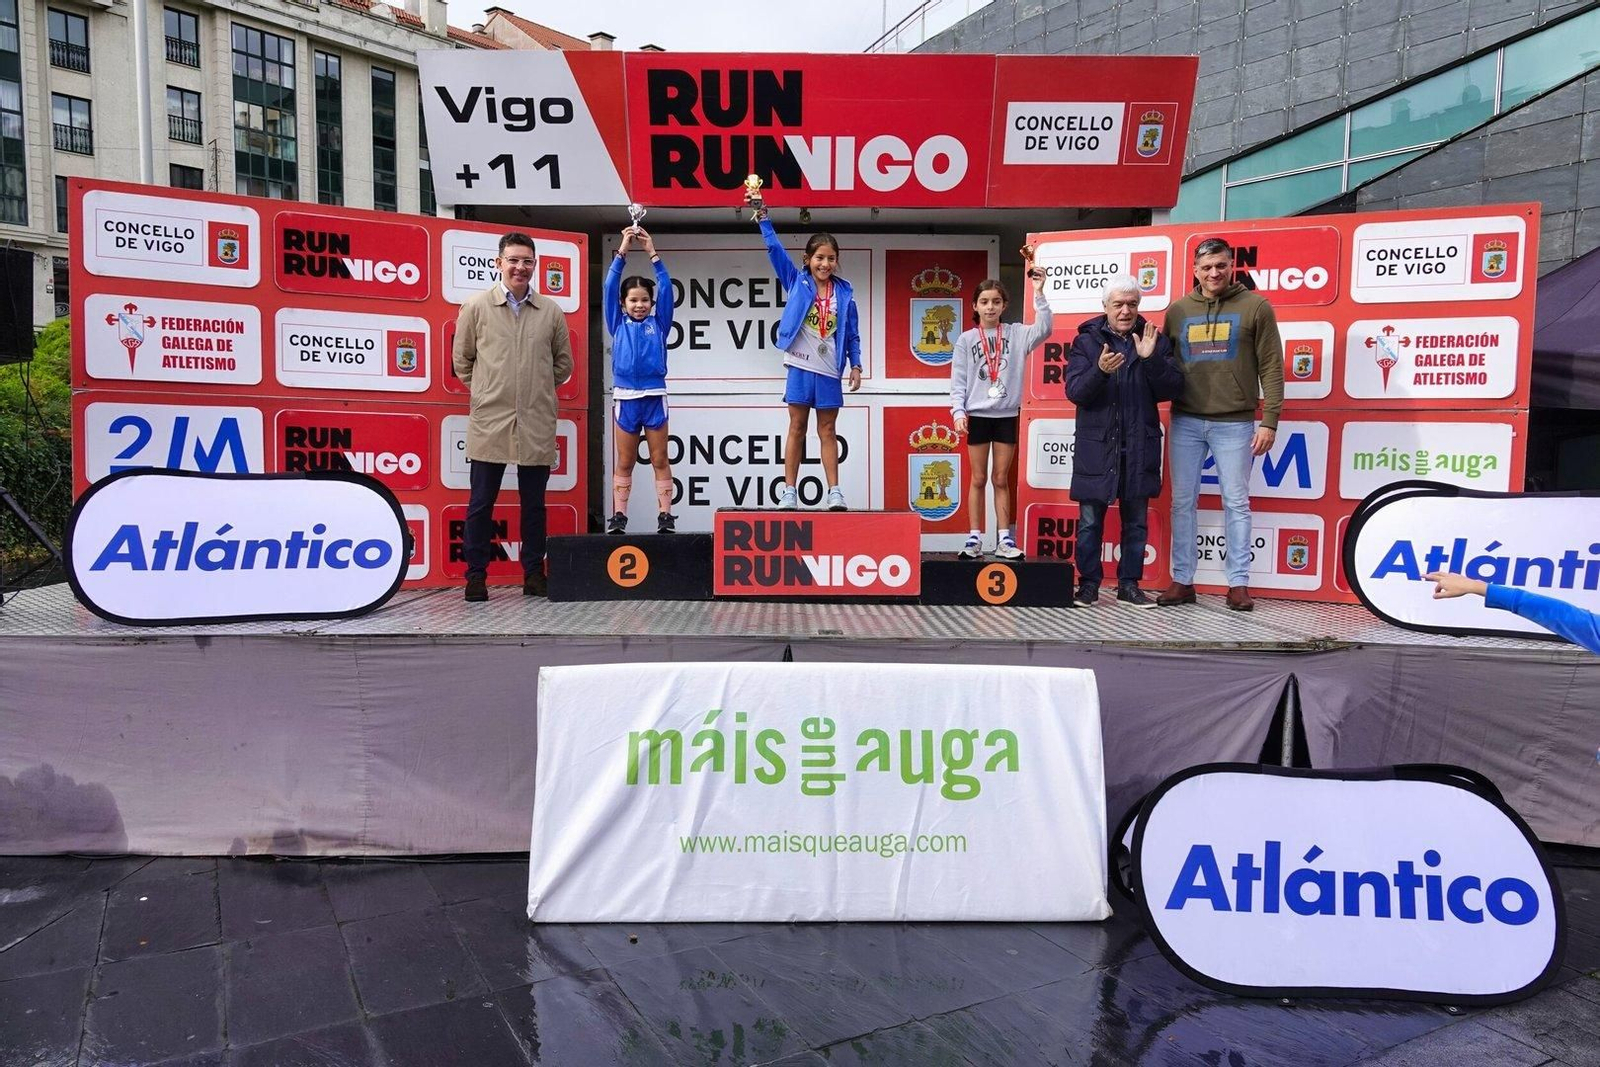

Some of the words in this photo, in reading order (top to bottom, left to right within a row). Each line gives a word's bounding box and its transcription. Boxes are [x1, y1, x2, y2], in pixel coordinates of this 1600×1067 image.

[647, 69, 803, 127] RUN
[434, 85, 574, 132] Vigo
[1014, 116, 1113, 132] CONCELLO
[1025, 136, 1049, 150] DE
[1056, 136, 1100, 151] VIGO
[455, 154, 561, 189] +11
[104, 220, 195, 240] CONCELLO
[115, 236, 138, 249] DE
[143, 239, 185, 254] VIGO
[283, 228, 349, 255] RUN
[1366, 246, 1458, 262] CONCELLO
[468, 269, 485, 281] DE
[1046, 263, 1119, 277] CONCELLO
[1376, 264, 1398, 276] DE
[1404, 262, 1446, 275] VIGO
[1053, 280, 1070, 291] DE
[161, 317, 244, 334] FEDERACIÓN
[162, 336, 212, 351] GALEGA
[217, 338, 233, 352] DE
[289, 334, 375, 350] CONCELLO
[1415, 332, 1499, 348] FEDERACIÓN
[162, 356, 236, 371] ATLETISMO
[300, 350, 321, 362] DE
[328, 352, 365, 365] VIGO
[1415, 353, 1465, 367] GALEGA
[1469, 353, 1486, 366] DE
[1413, 372, 1488, 386] ATLETISMO
[285, 426, 351, 449] RUN
[1050, 455, 1066, 465] DE
[1353, 447, 1411, 471] máis
[1415, 450, 1431, 475] que
[1435, 453, 1497, 478] auga
[723, 520, 813, 551] RUN
[1038, 518, 1078, 537] RU
[89, 522, 392, 571] Atlántico
[619, 553, 637, 580] 2
[989, 569, 1006, 597] 3
[626, 709, 787, 785] máis
[800, 716, 836, 796] que
[856, 728, 1020, 800] auga
[680, 831, 967, 858] www.maisqueauga.com
[1165, 841, 1539, 926] Atlántico
